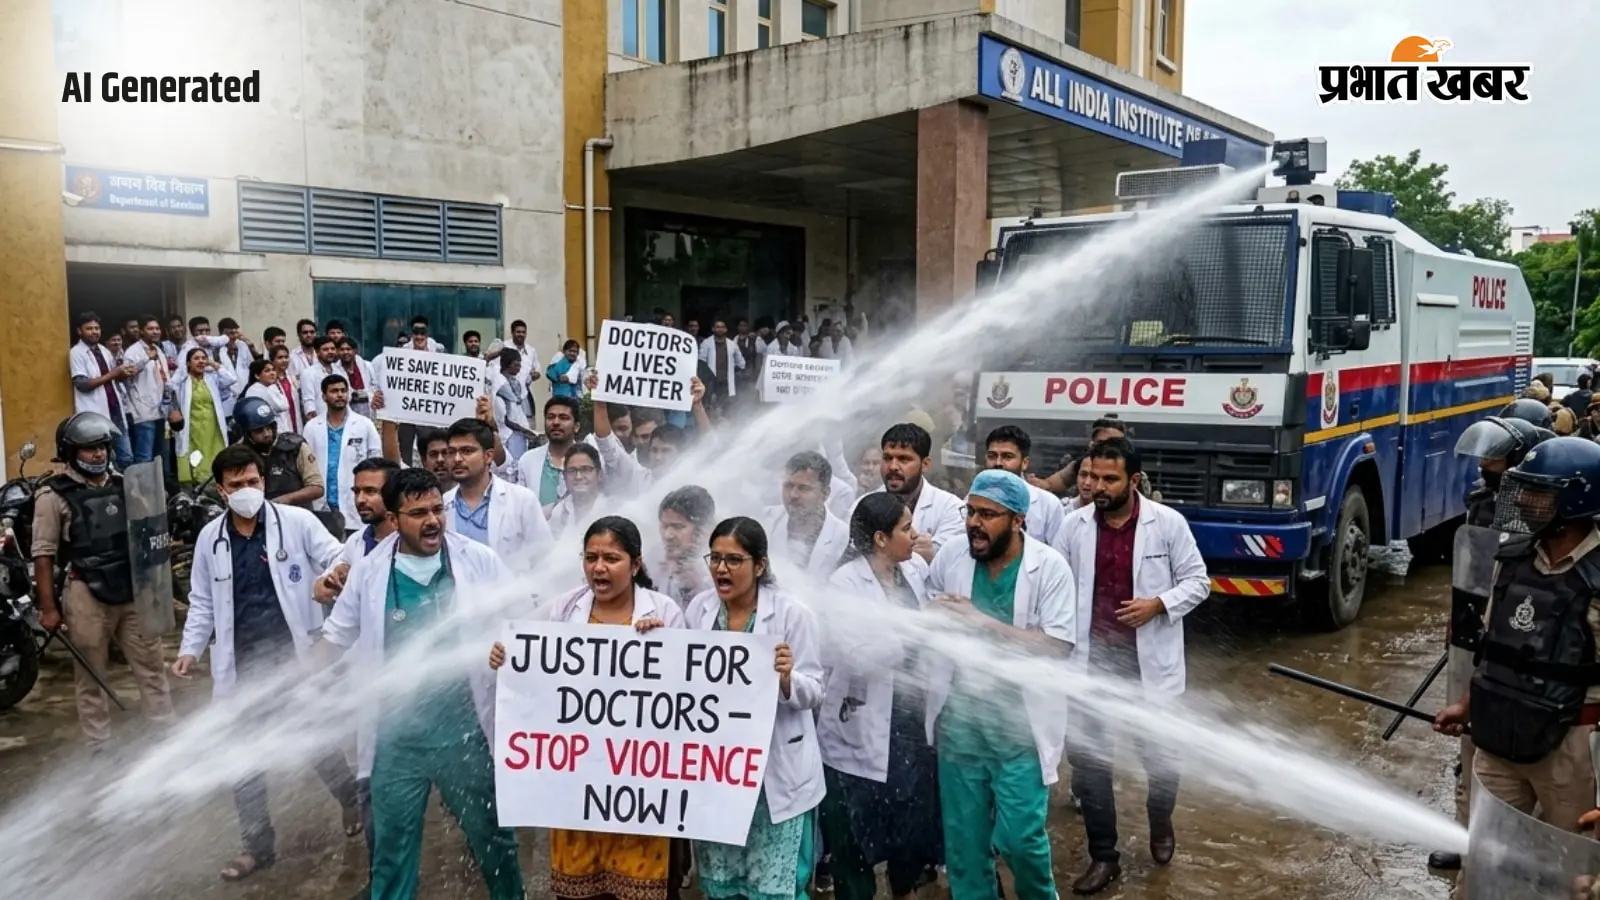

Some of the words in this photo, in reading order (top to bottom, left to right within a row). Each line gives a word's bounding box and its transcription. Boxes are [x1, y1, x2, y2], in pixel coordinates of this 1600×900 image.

[1030, 66, 1064, 108] ALL
[1068, 79, 1112, 124] INDIA
[1114, 96, 1183, 148] INSTITUTE
[1472, 275, 1507, 310] POLICE
[608, 326, 693, 354] DOCTORS
[385, 355, 404, 372] WE
[407, 358, 439, 376] SAVE
[442, 363, 480, 382] LIVES.
[621, 351, 677, 376] LIVES
[386, 375, 430, 394] WHERE
[433, 381, 445, 396] IS
[448, 383, 474, 400] OUR
[604, 373, 683, 401] MATTER
[1044, 377, 1186, 407] POLICE
[401, 396, 455, 417] SAFETY?
[511, 633, 663, 680] JUSTICE
[685, 643, 752, 686] FOR
[504, 731, 590, 772] STOP
[605, 737, 763, 788] VIOLENCE
